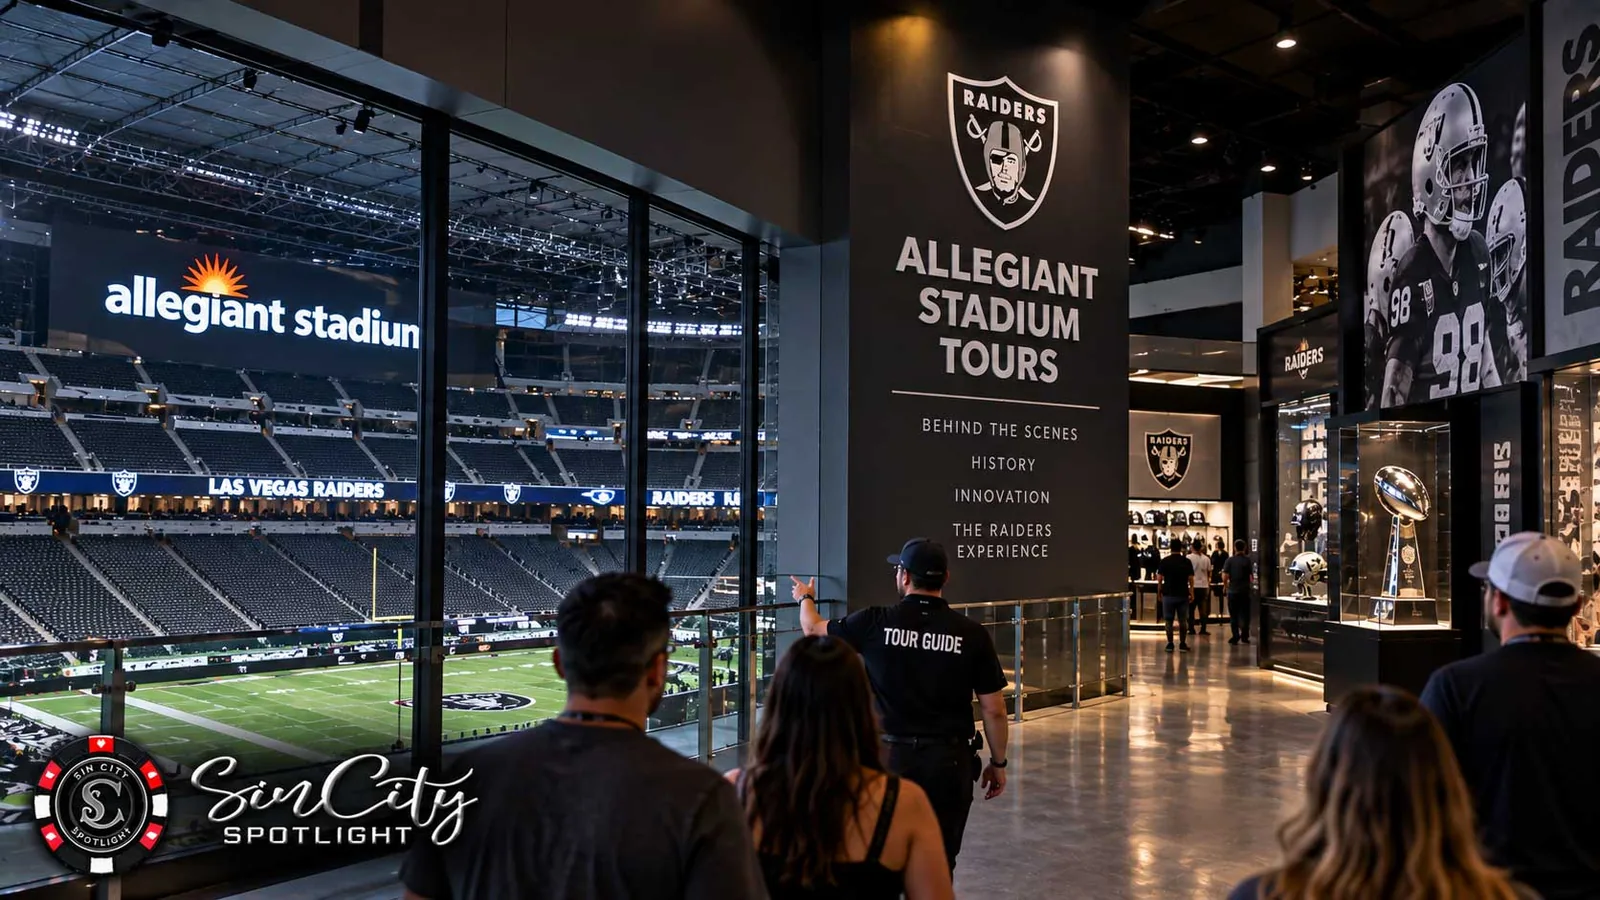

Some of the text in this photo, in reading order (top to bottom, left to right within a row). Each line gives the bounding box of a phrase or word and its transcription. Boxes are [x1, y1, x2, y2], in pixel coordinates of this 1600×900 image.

[963, 88, 1047, 125] RAIDERS
[1562, 23, 1600, 316] RAIDERS
[896, 236, 1099, 299] ALLEGIANT
[105, 275, 285, 334] allegiant
[918, 287, 1080, 341] STADIUM
[1390, 285, 1412, 328] 98
[939, 336, 1059, 384] TOURS
[1284, 346, 1324, 372] RAIDERS
[1429, 301, 1485, 400] 98
[922, 418, 1079, 441] BEHIND THE SCENES
[1150, 436, 1188, 445] RAIDERS
[971, 455, 1036, 472] HISTORY
[208, 477, 385, 499] LAS VEGAS RAIDERS
[651, 491, 715, 506] RAIDERS
[954, 488, 1050, 504] INNOVATION
[953, 523, 1052, 537] THE RAIDERS
[957, 544, 1048, 558] EXPERIENCE
[883, 627, 963, 654] TOUR GUIDE
